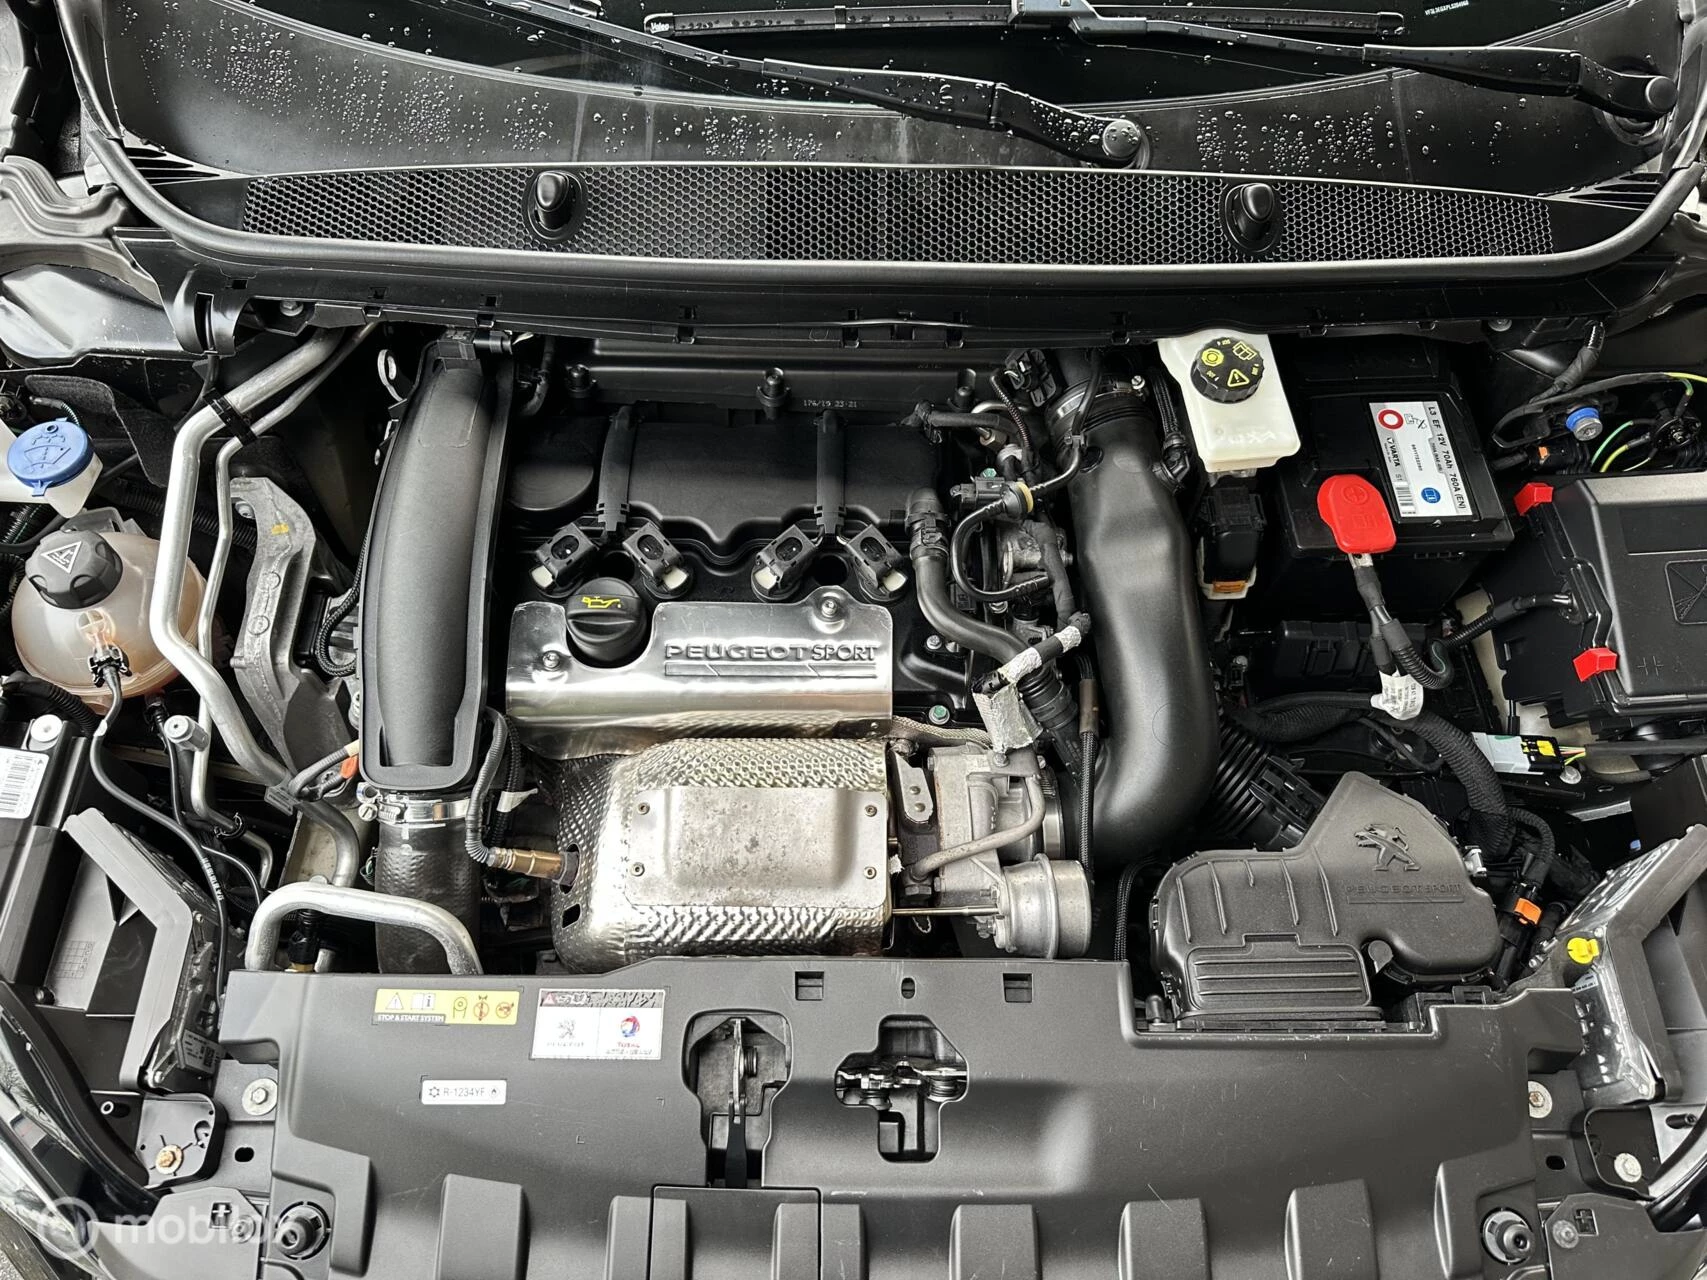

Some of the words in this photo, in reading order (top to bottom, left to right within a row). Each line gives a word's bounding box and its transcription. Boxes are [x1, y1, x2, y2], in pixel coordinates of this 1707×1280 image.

[1428, 406, 1437, 416] L3
[1432, 419, 1442, 429] EF
[1437, 433, 1447, 446] 12V
[1389, 444, 1401, 467] VARTA
[1443, 450, 1453, 469] 70Ah
[1450, 473, 1460, 492] 760A
[1455, 492, 1467, 509] (EN)
[664, 643, 809, 660] PEUGEOT
[811, 643, 877, 661] SPORT
[377, 1014, 394, 1022] STOP
[400, 1014, 420, 1022] START
[420, 1014, 445, 1023] SYSTEM
[443, 1087, 485, 1097] R-1234YF
